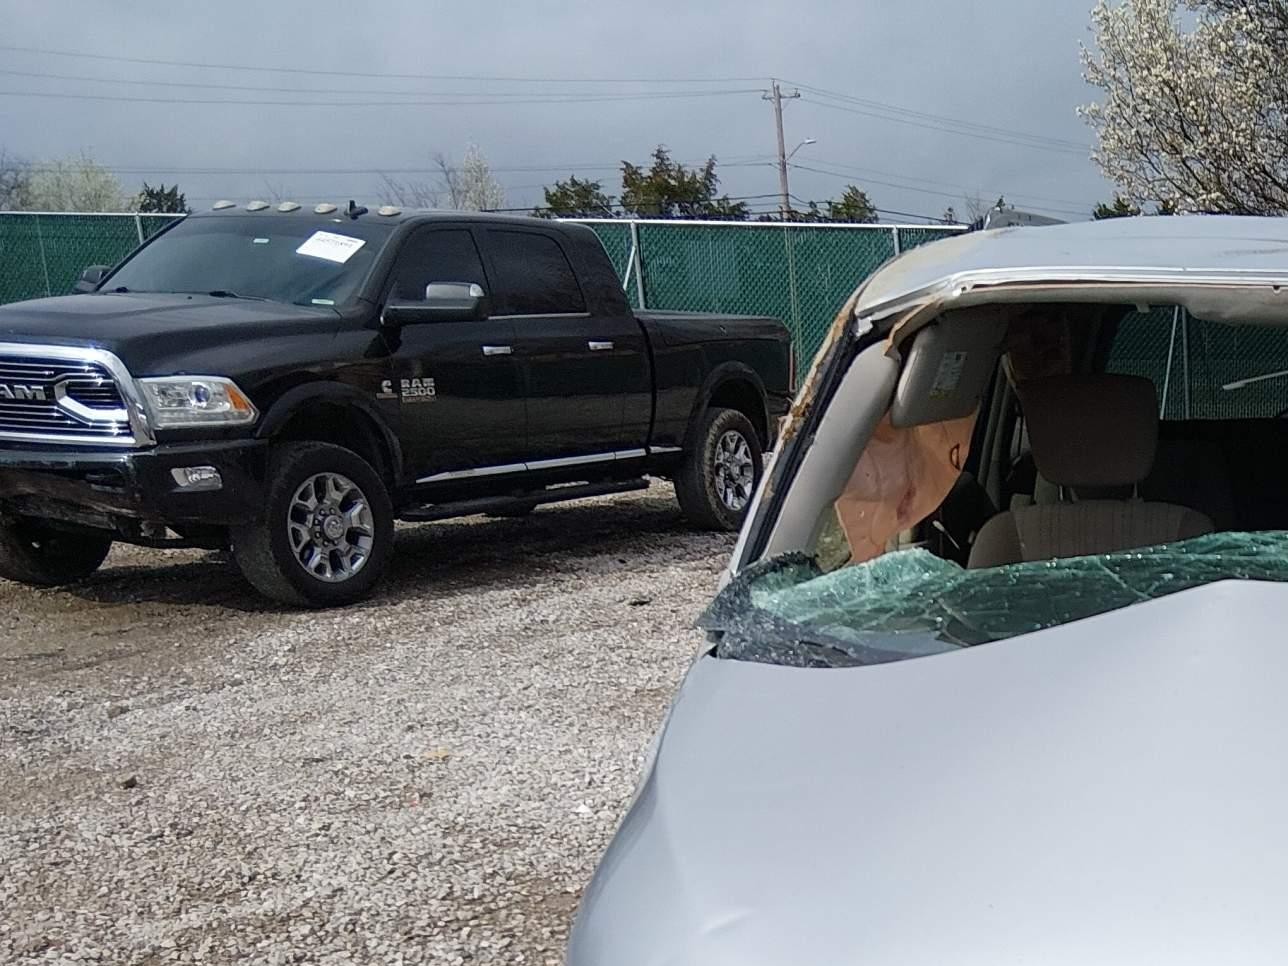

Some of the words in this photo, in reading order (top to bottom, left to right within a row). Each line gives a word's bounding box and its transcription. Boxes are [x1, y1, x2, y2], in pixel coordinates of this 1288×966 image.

[400, 378, 435, 388] RAM
[0, 384, 46, 400] AM
[400, 387, 436, 397] 2500
